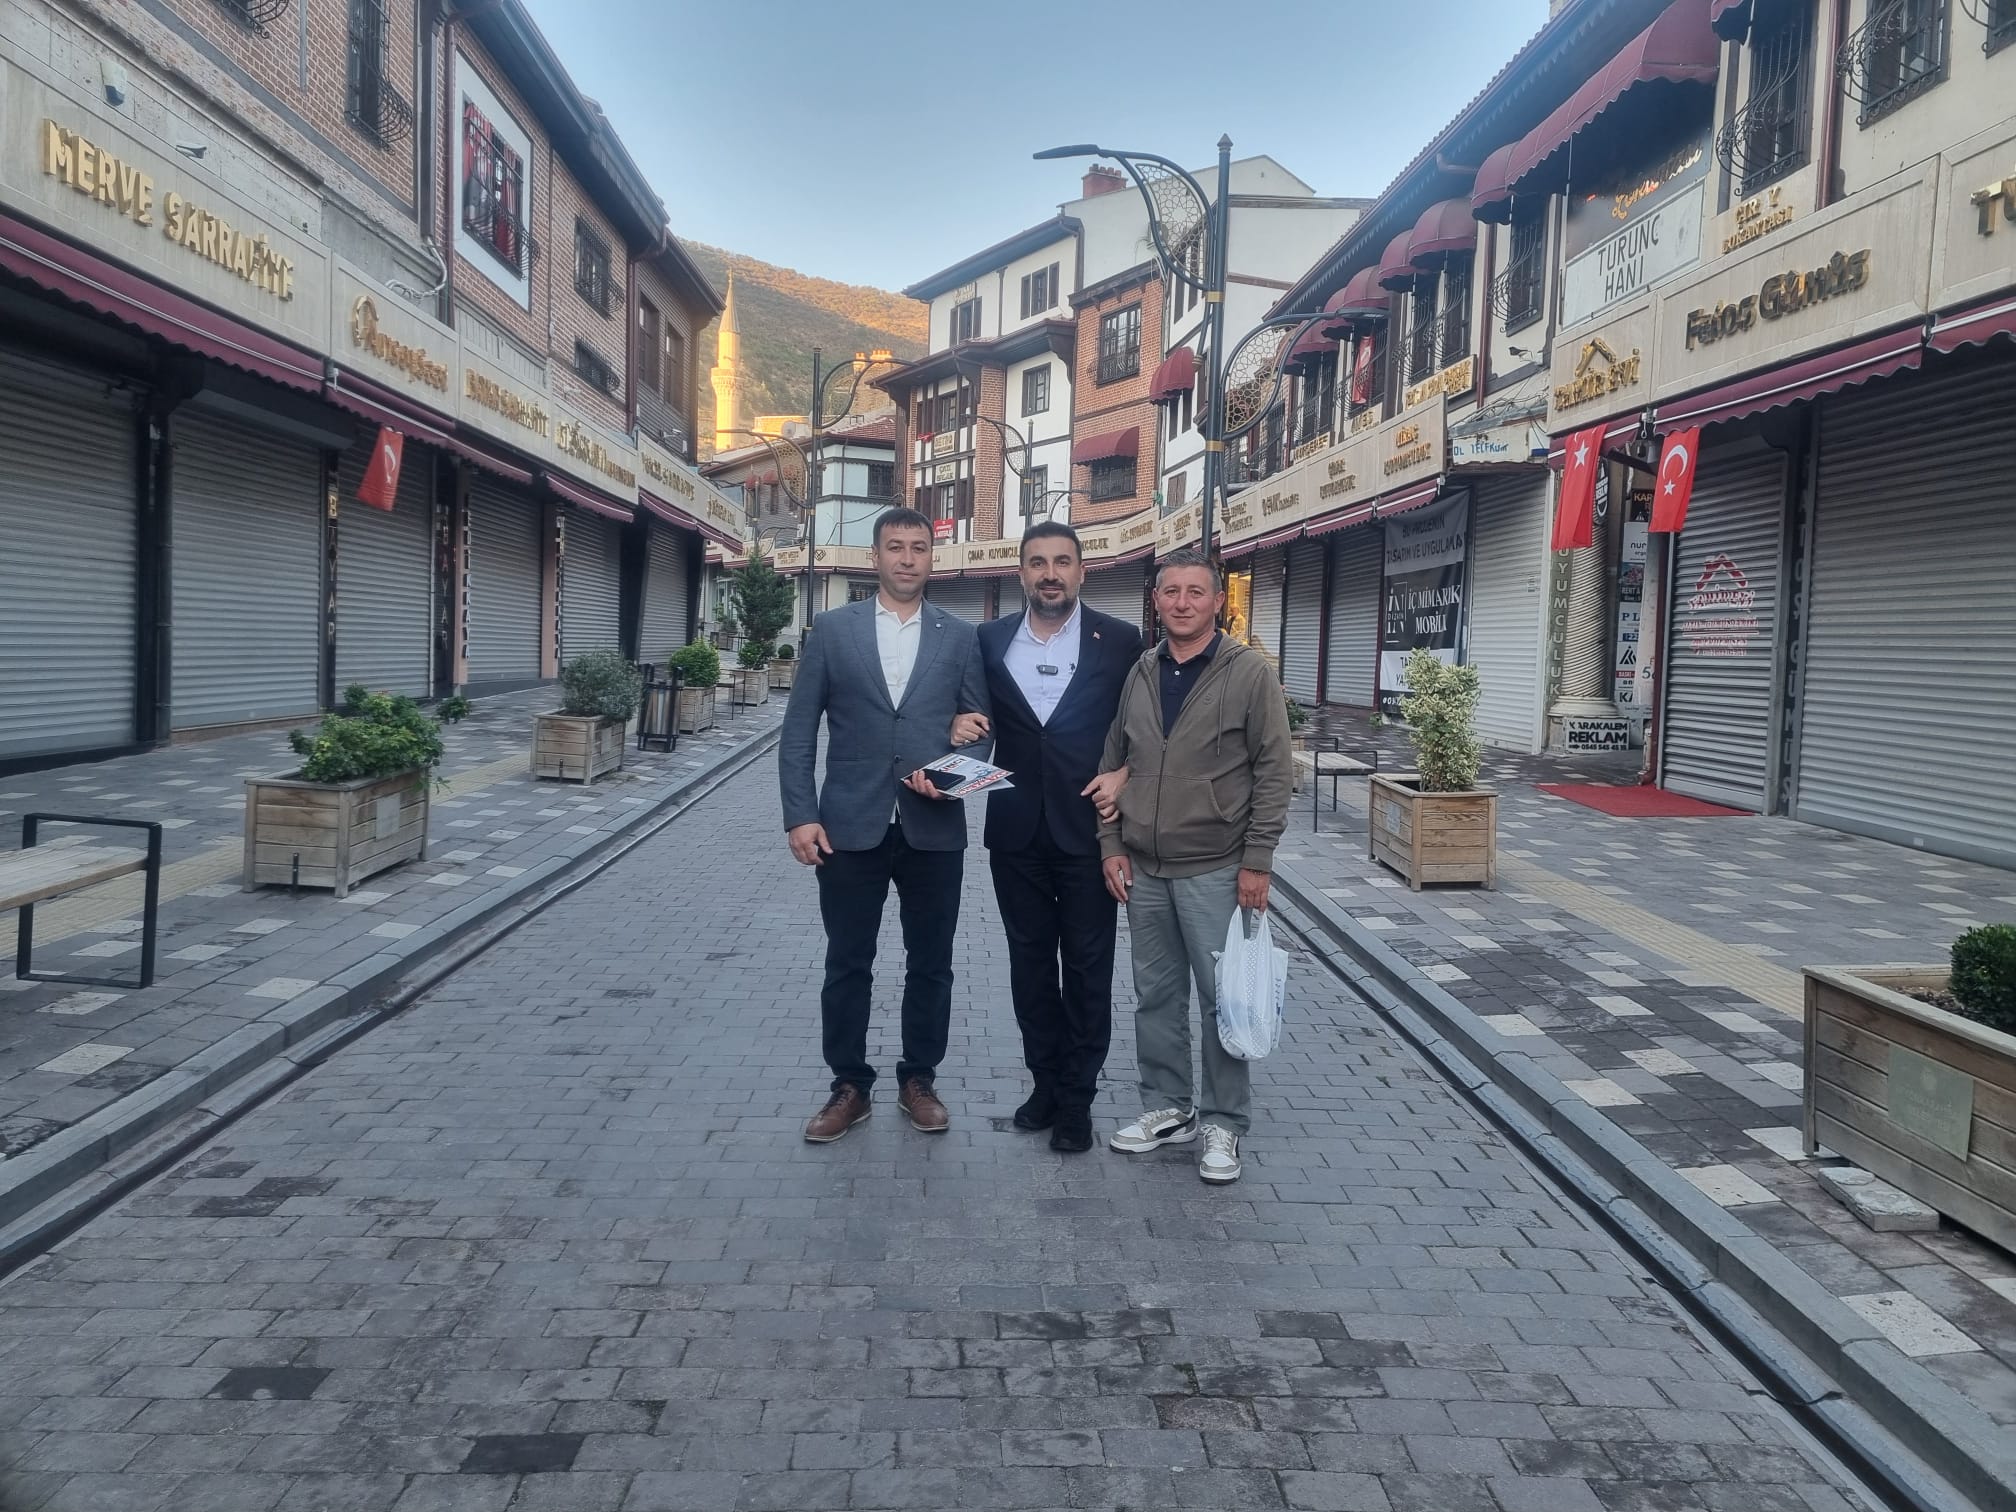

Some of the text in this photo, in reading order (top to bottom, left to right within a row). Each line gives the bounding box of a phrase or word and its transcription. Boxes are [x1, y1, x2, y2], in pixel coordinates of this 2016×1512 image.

[42, 118, 154, 227] MERVE
[1605, 255, 1643, 303] HANI
[988, 546, 1020, 560] KUYUMCUL
[1550, 548, 1569, 695] UYUMCULUK
[1569, 721, 1627, 731] KARAKALEM
[1569, 731, 1627, 744] REKLAM
